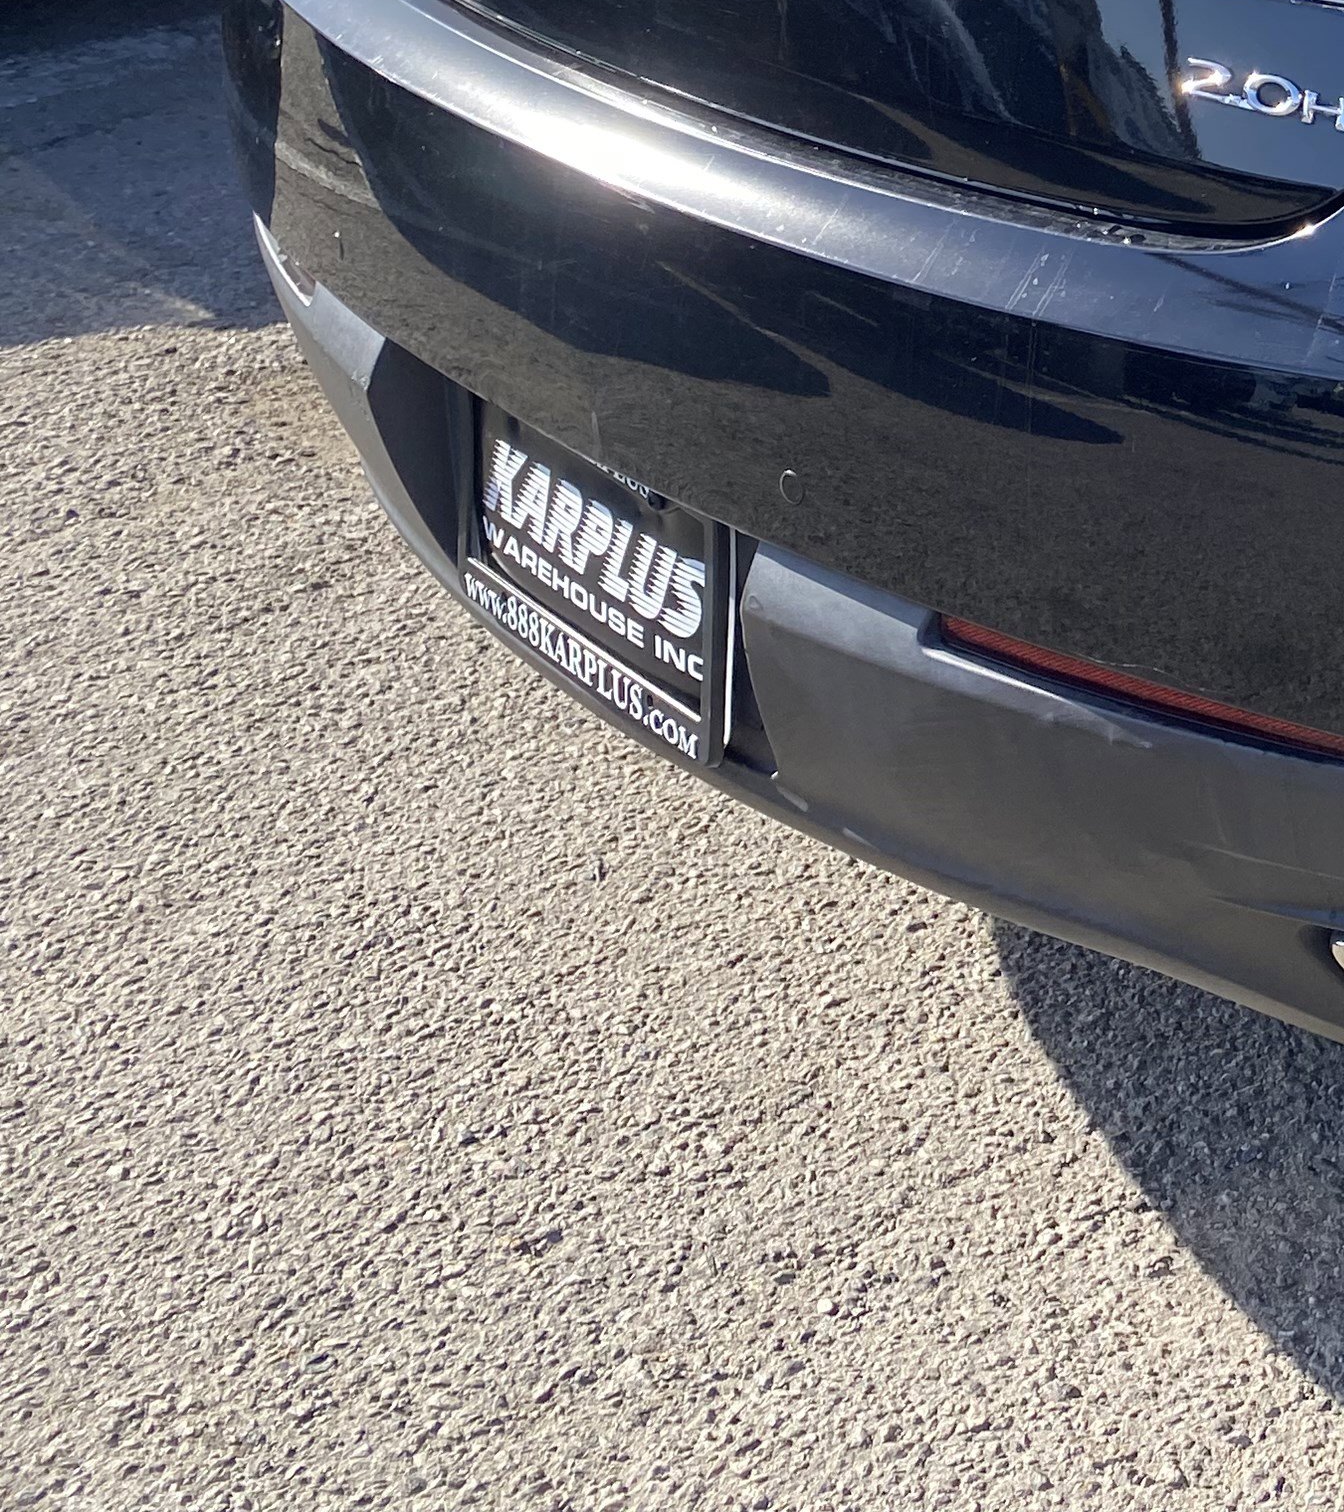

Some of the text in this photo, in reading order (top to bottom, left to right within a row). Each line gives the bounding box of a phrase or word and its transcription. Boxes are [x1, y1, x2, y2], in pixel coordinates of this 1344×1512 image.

[481, 514, 704, 681] WAREHOUSE INC
[483, 438, 706, 639] KARPLUS
